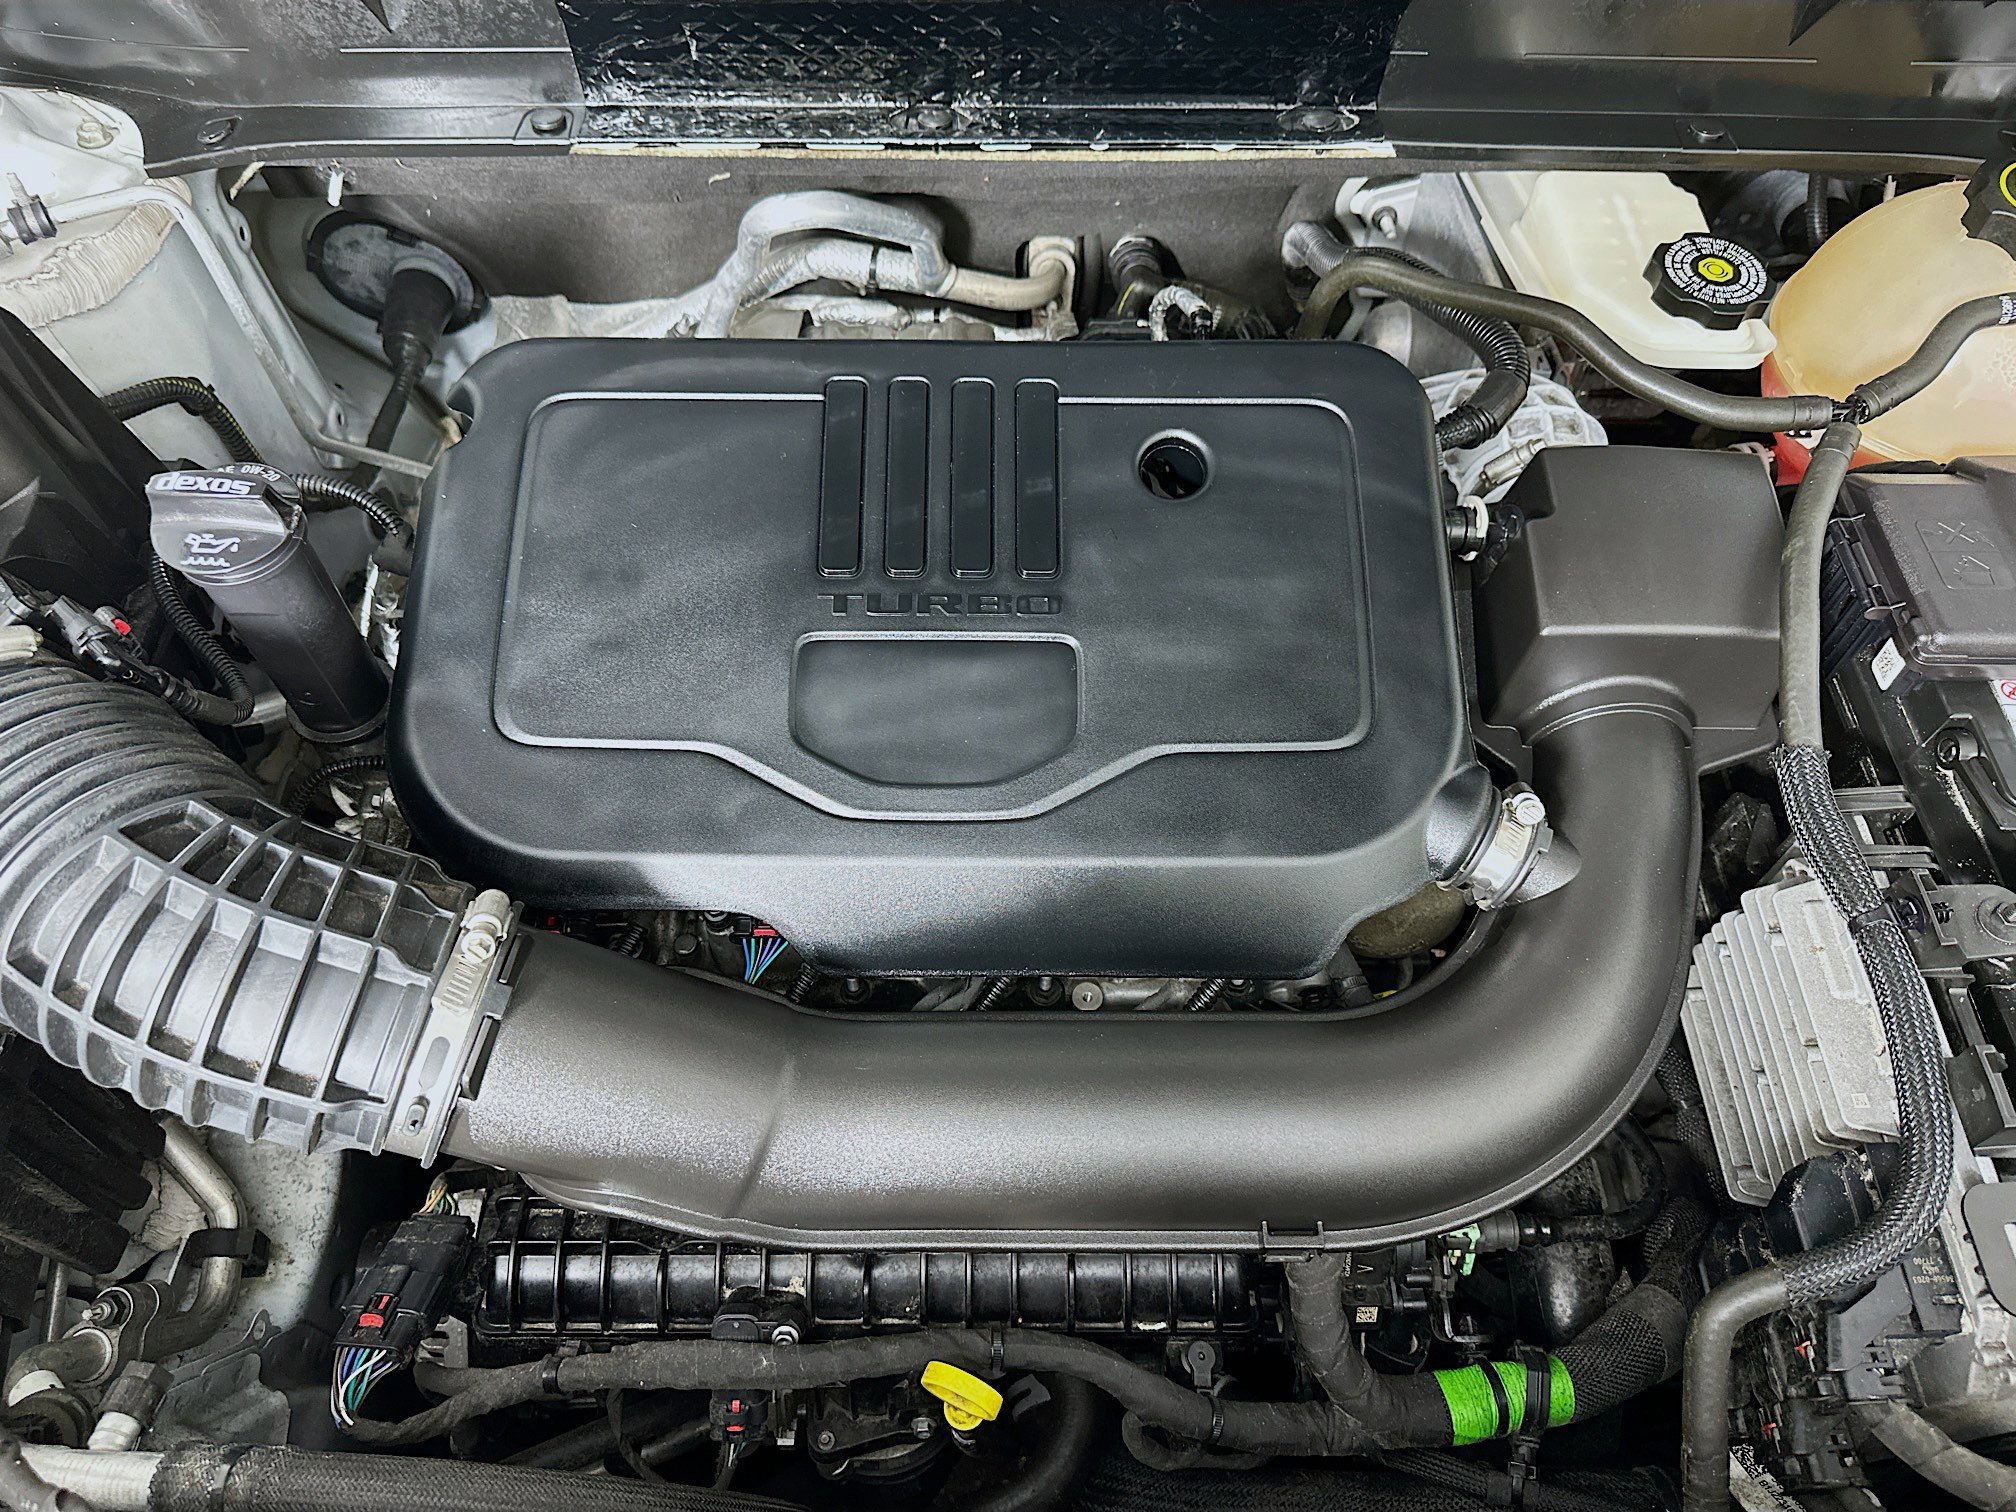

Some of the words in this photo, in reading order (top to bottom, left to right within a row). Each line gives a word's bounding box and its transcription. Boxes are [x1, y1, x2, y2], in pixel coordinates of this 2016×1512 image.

[155, 472, 256, 495] dexos
[240, 464, 281, 482] 0W-20
[817, 593, 1063, 617] TURBO
